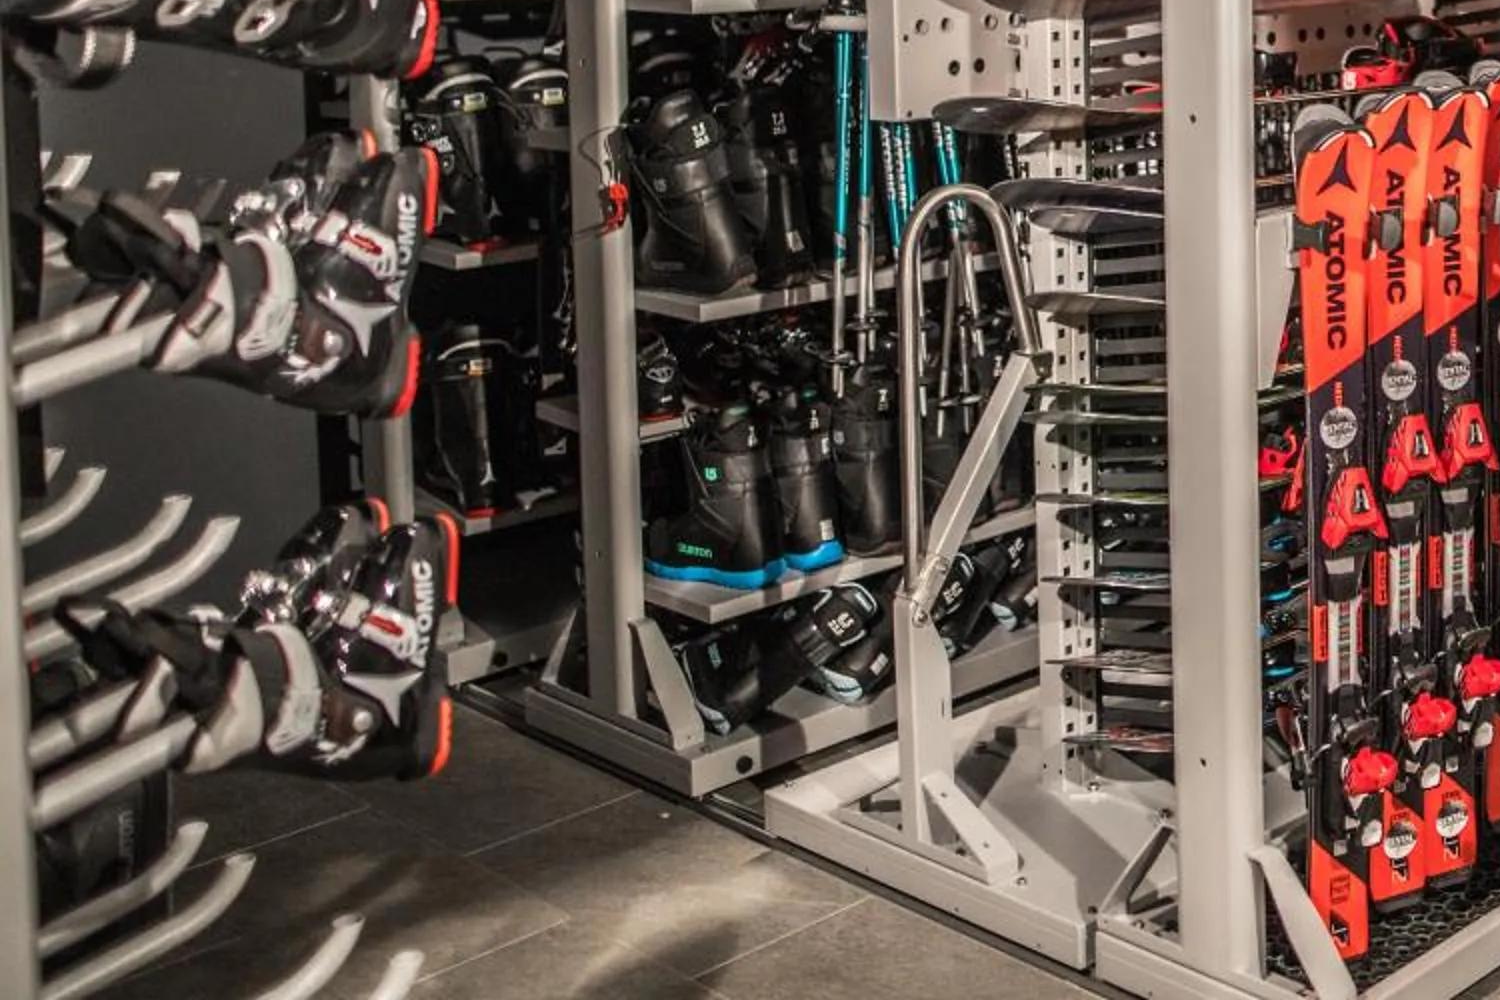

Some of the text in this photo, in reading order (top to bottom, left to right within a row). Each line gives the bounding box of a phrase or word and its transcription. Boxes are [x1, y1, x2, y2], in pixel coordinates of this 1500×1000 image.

[1325, 210, 1347, 350] ATOMIC
[1386, 169, 1406, 304] ATMIC
[1443, 166, 1462, 296] AMIC
